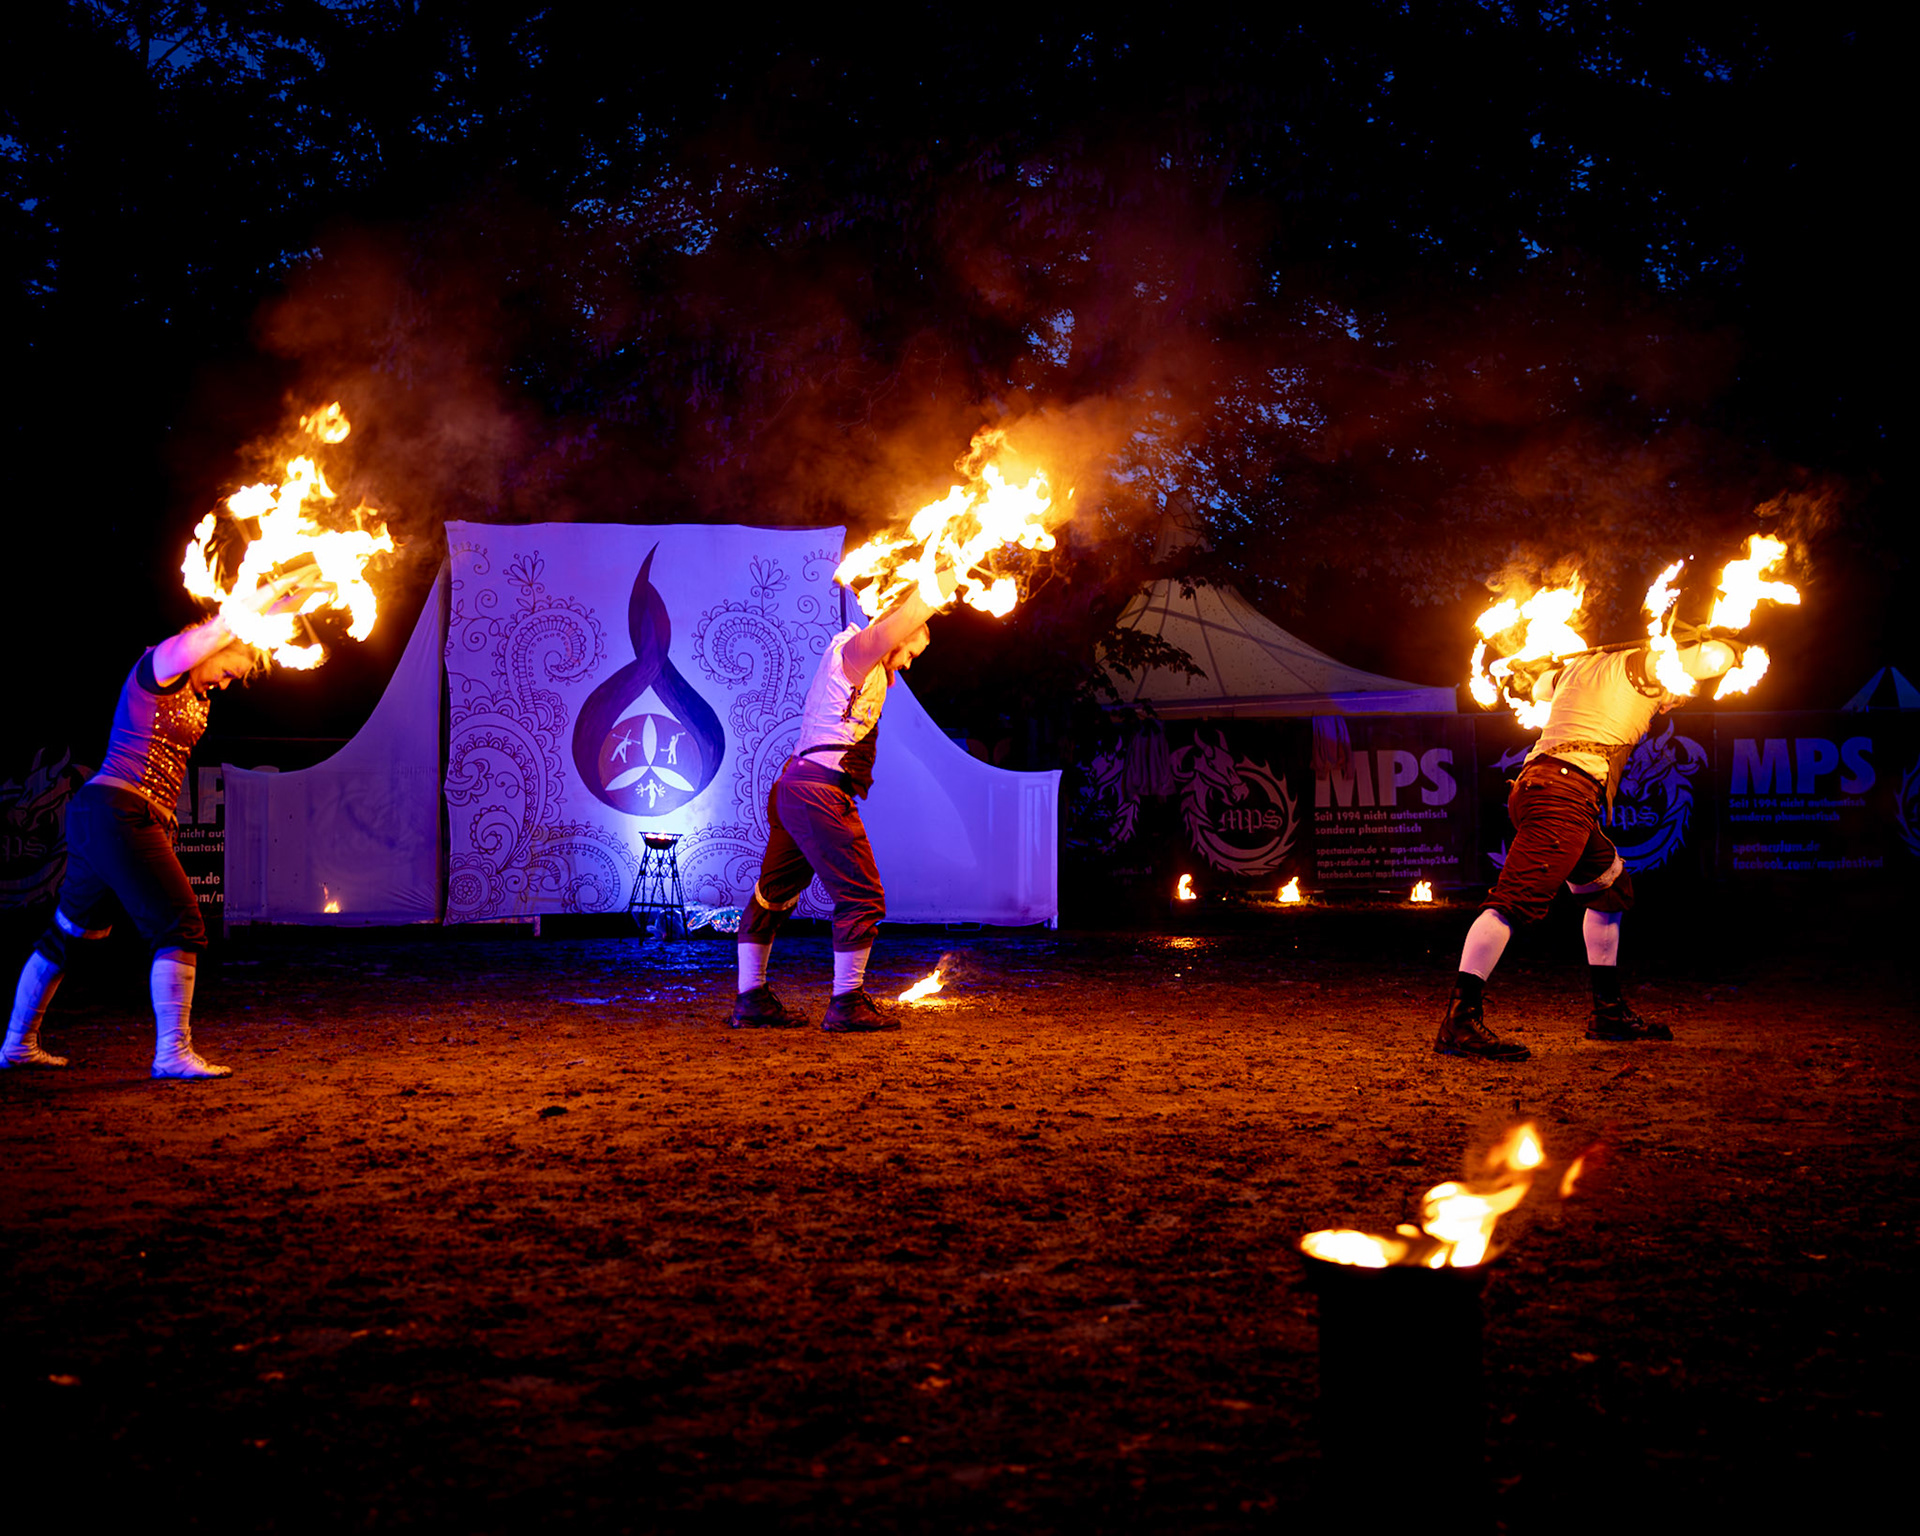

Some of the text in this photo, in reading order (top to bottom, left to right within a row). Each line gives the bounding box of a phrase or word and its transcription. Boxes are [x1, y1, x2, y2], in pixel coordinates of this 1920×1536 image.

[1729, 736, 1877, 794] MPS
[1315, 748, 1457, 807] MPS
[1729, 797, 1749, 808] Seit
[1753, 797, 1777, 808] 1994
[1779, 797, 1805, 808] nicht
[1314, 808, 1448, 822] Seit 1994 nicht authentisch
[1729, 811, 1772, 822] sondern
[180, 828, 206, 839] nicht
[1315, 822, 1422, 836] sondern phantastisch
[174, 842, 225, 855] phantasti
[1316, 844, 1377, 856] spectaculum.de
